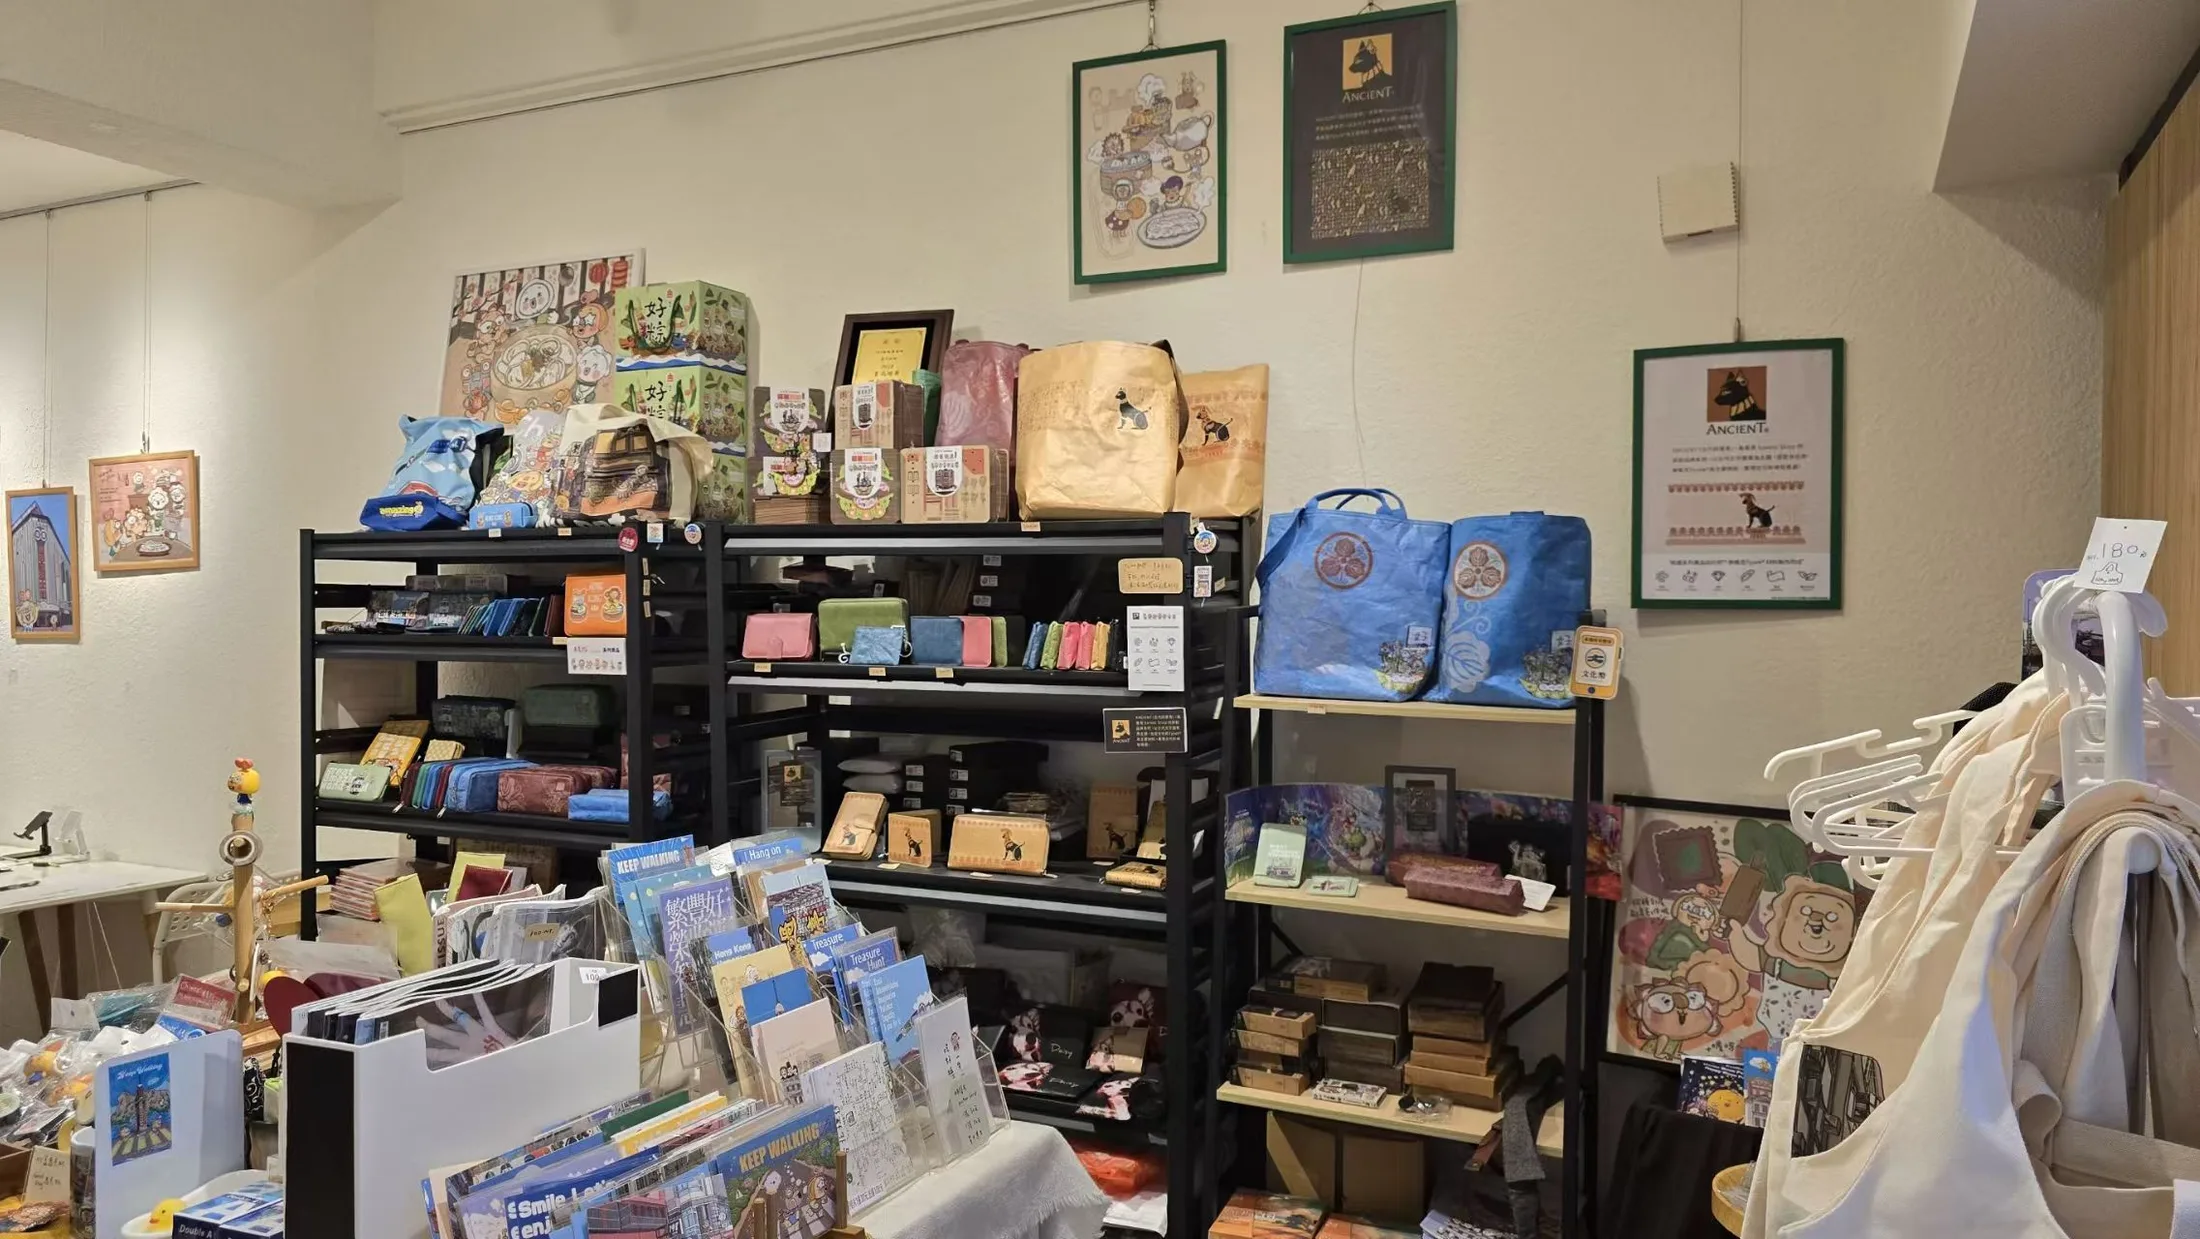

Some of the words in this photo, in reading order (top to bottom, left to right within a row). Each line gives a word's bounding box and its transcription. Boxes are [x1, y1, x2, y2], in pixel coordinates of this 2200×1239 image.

[1342, 86, 1393, 103] ANCIENT
[1706, 421, 1767, 435] ANCIENT
[616, 858, 640, 875] KEEP
[640, 849, 681, 871] WALKING
[749, 847, 771, 861] Hang
[771, 845, 782, 855] on
[811, 932, 844, 951] Treasure
[713, 949, 733, 961] Hong
[733, 942, 753, 956] Kong
[849, 947, 881, 966] Treasure
[866, 956, 886, 972] Hunt
[1050, 1043, 1073, 1060] Daisy
[739, 1146, 768, 1173] KEEP
[767, 1122, 820, 1160] WALKING
[517, 1193, 566, 1219] Smile
[178, 1223, 205, 1237] Double
[206, 1230, 213, 1239] A
